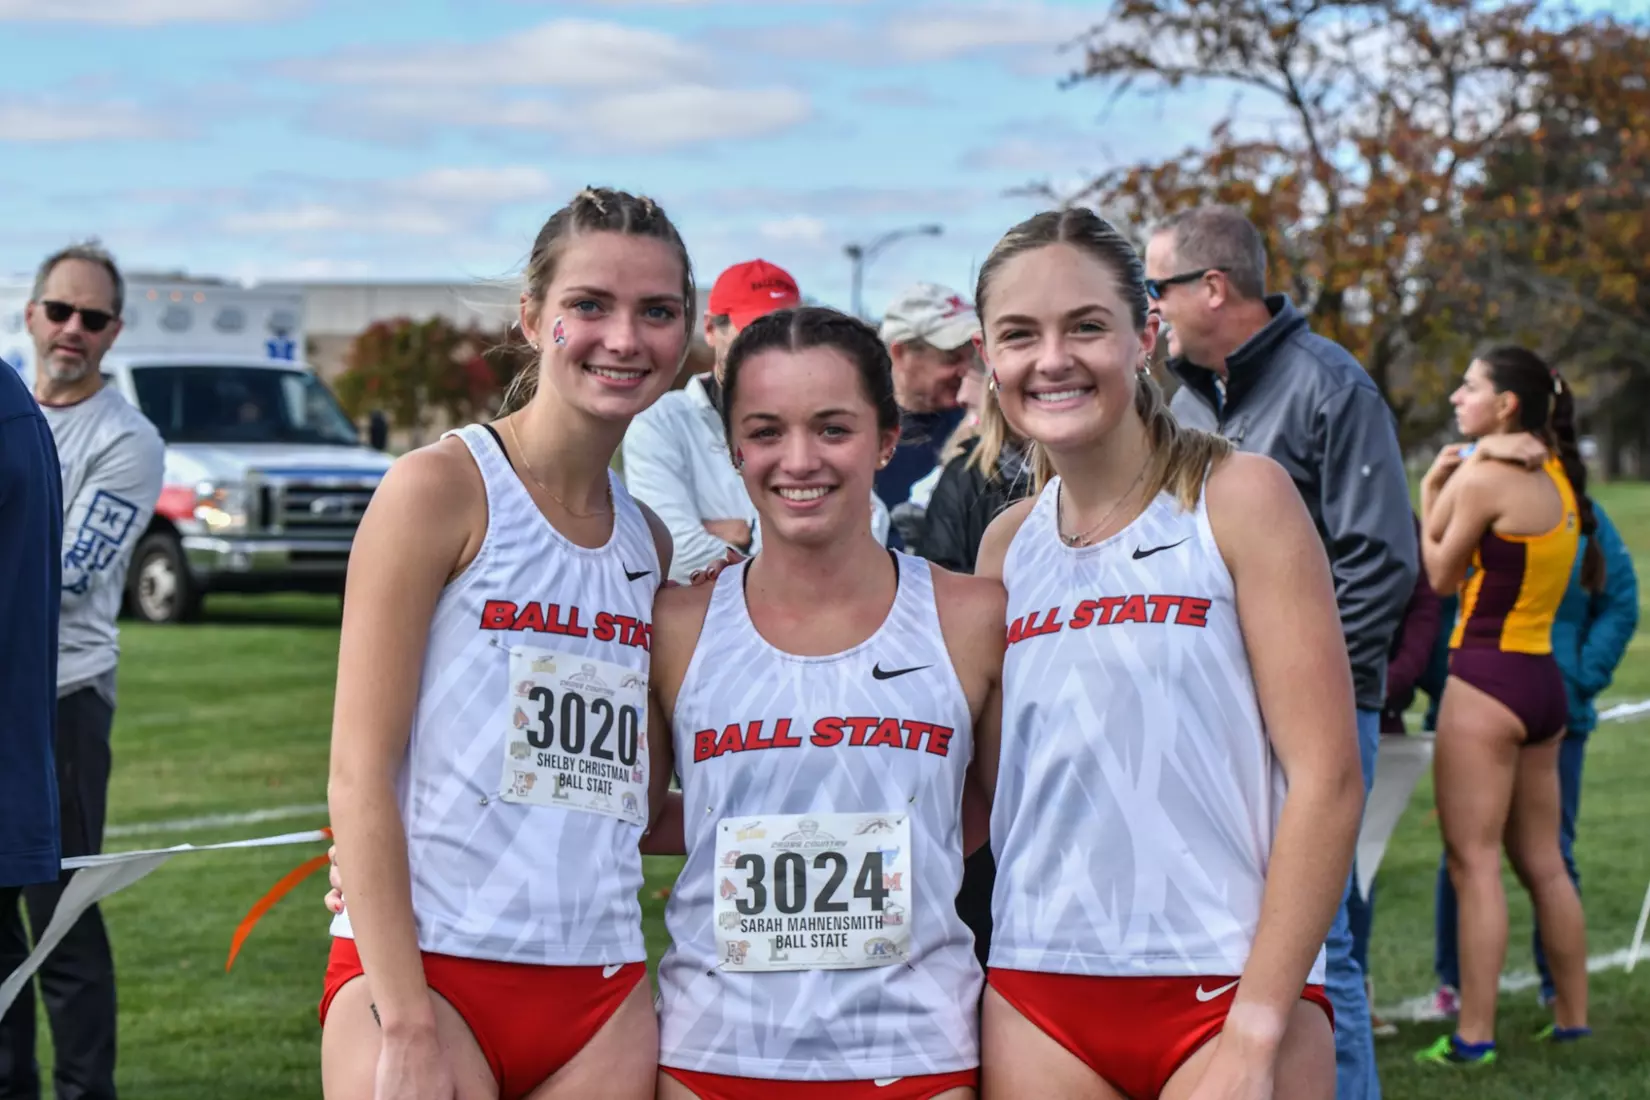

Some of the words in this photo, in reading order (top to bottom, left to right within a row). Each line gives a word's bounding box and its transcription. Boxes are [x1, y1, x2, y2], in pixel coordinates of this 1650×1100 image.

[479, 600, 589, 638] BALL
[1006, 606, 1063, 652] ALL
[1069, 594, 1212, 628] STATE
[526, 686, 640, 767] 3020
[694, 718, 802, 763] BALL
[810, 716, 954, 758] STATE
[536, 752, 576, 772] SHELBY
[578, 759, 630, 783] CHRISTMAN
[559, 772, 584, 790] BALL
[586, 778, 613, 796] STATE
[734, 851, 889, 915] 3024
[740, 917, 783, 933] SARAH
[787, 915, 884, 932] MAHNENSMITH
[776, 933, 807, 949] BALL
[811, 933, 848, 948] STATE
